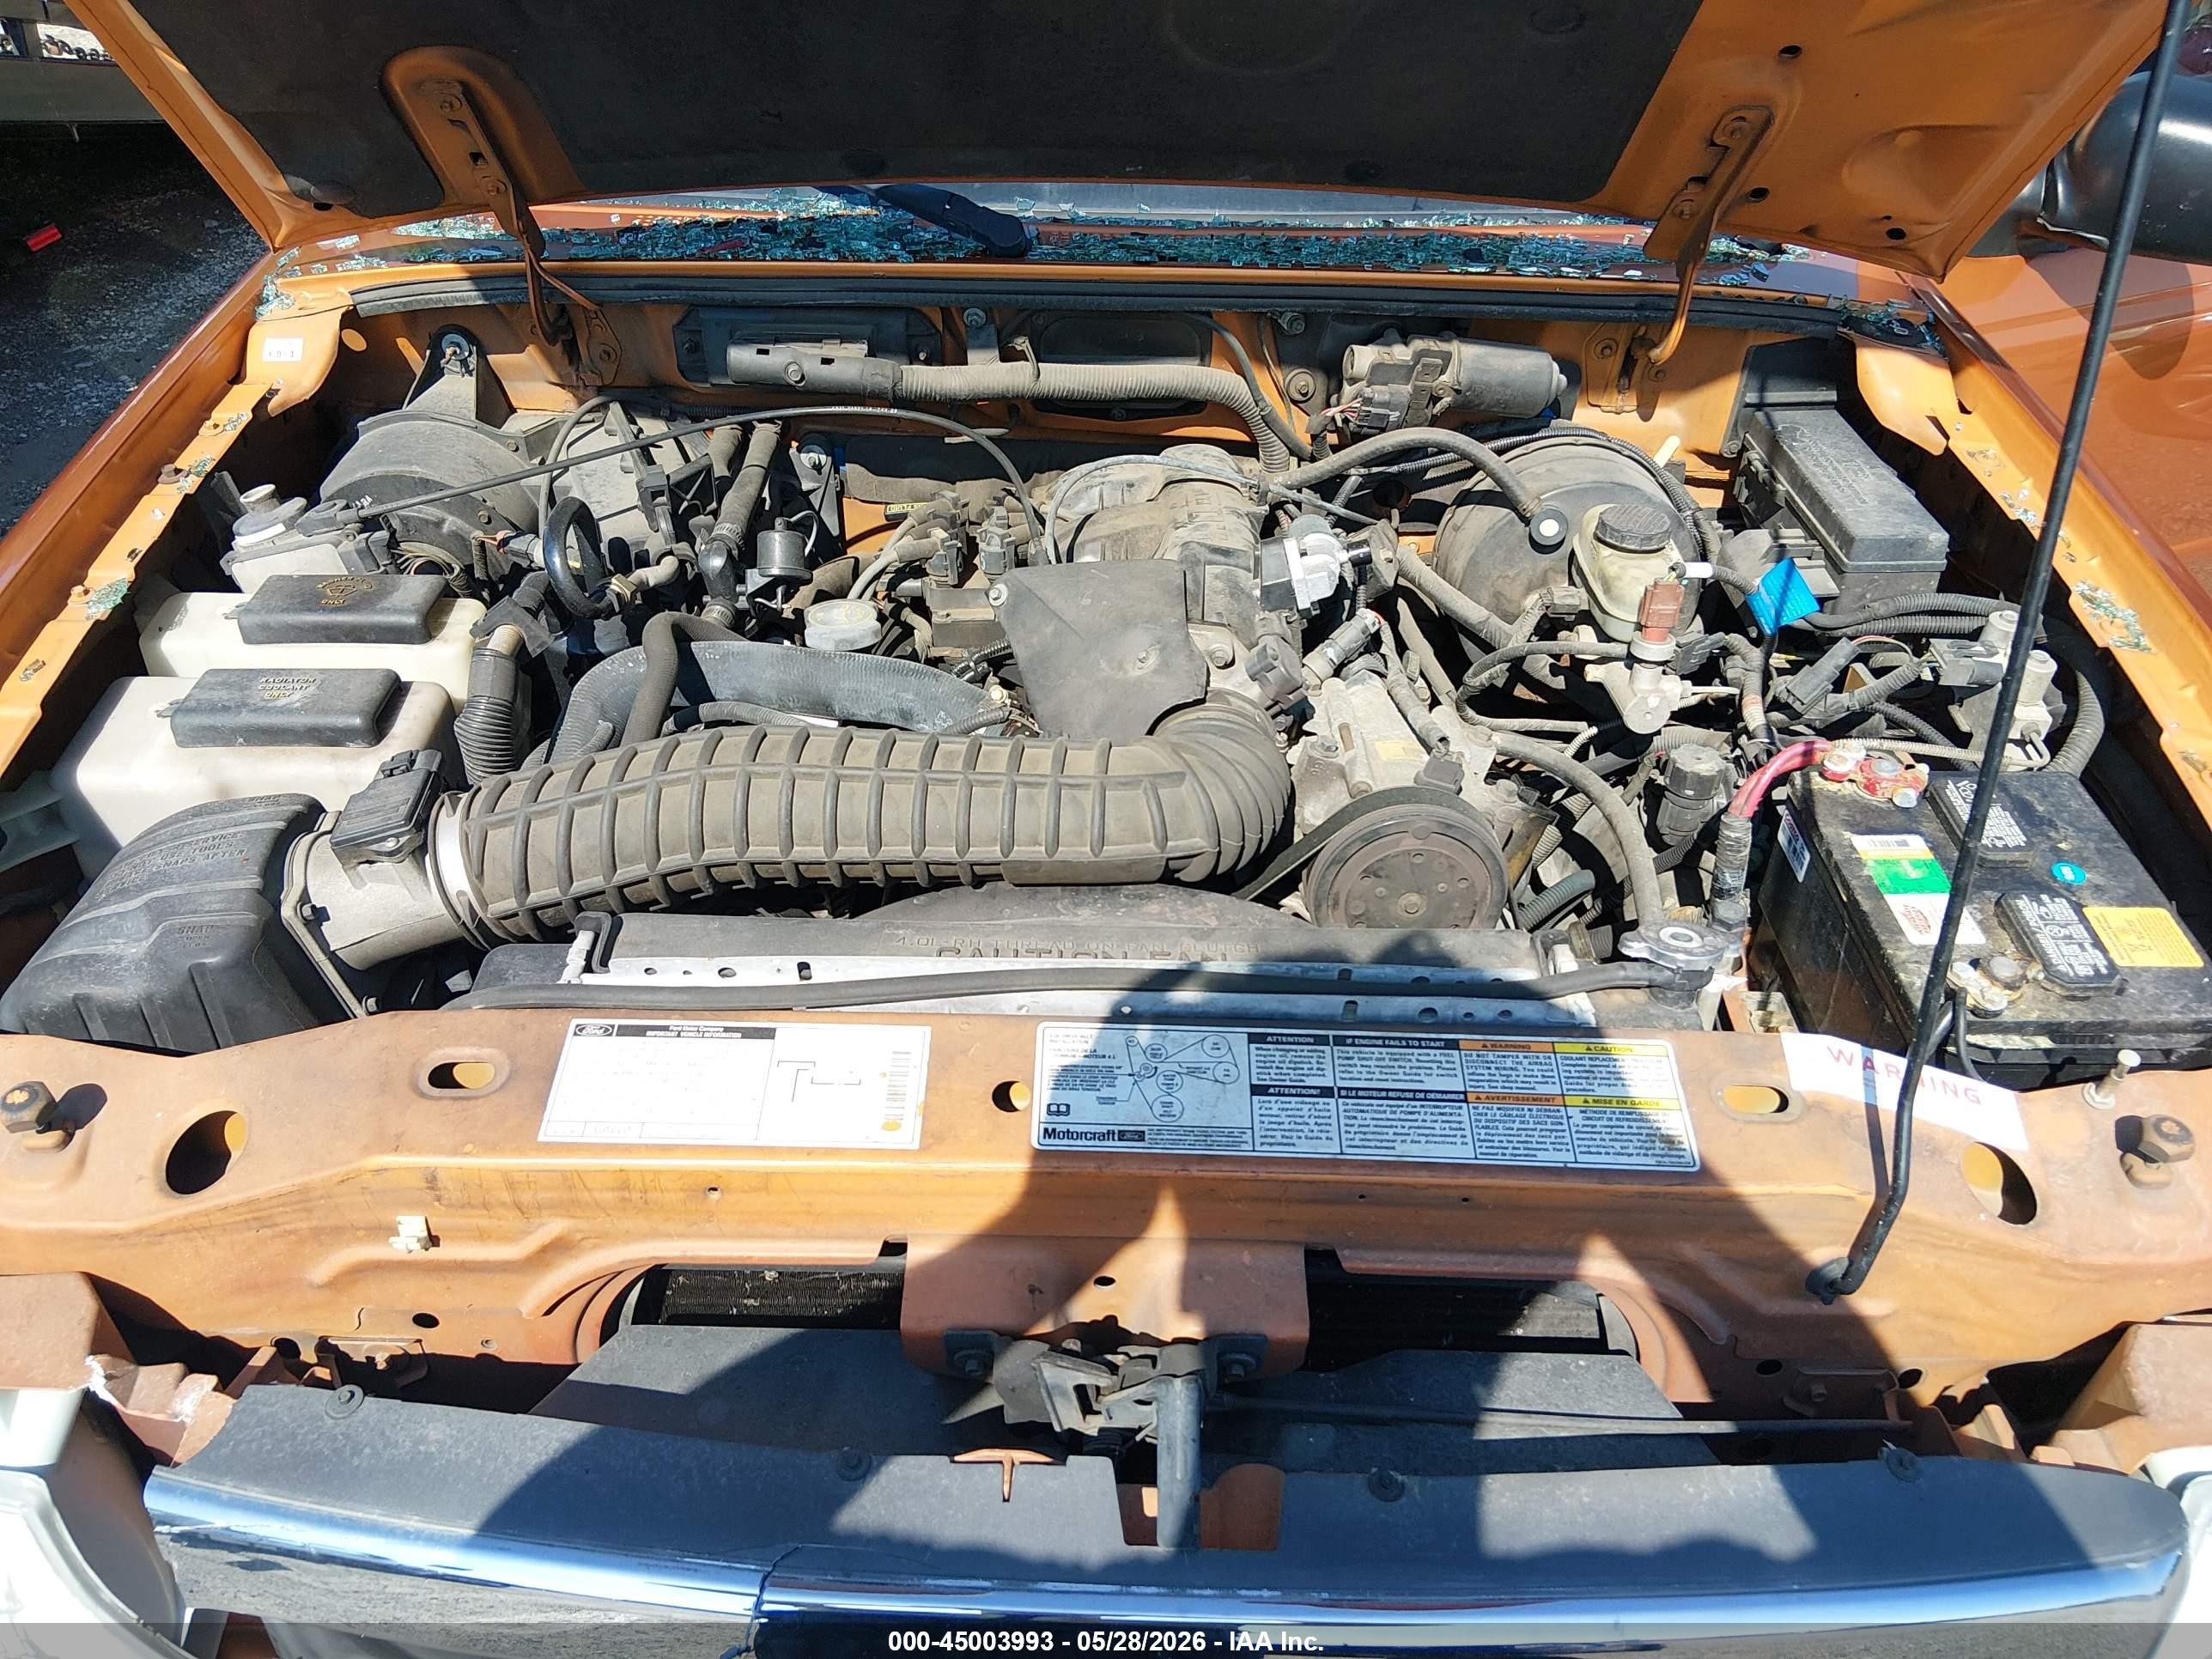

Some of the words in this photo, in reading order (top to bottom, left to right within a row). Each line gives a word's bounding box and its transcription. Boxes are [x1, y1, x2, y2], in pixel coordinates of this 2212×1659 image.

[153, 857, 195, 871] SNAPS
[203, 849, 246, 861] AFTER
[178, 924, 213, 934] SNAP
[1085, 941, 1116, 952] ON
[1126, 942, 1166, 953] FAN
[1182, 943, 1260, 953] CLUTCH
[1043, 1127, 1116, 1141] Motorcraft
